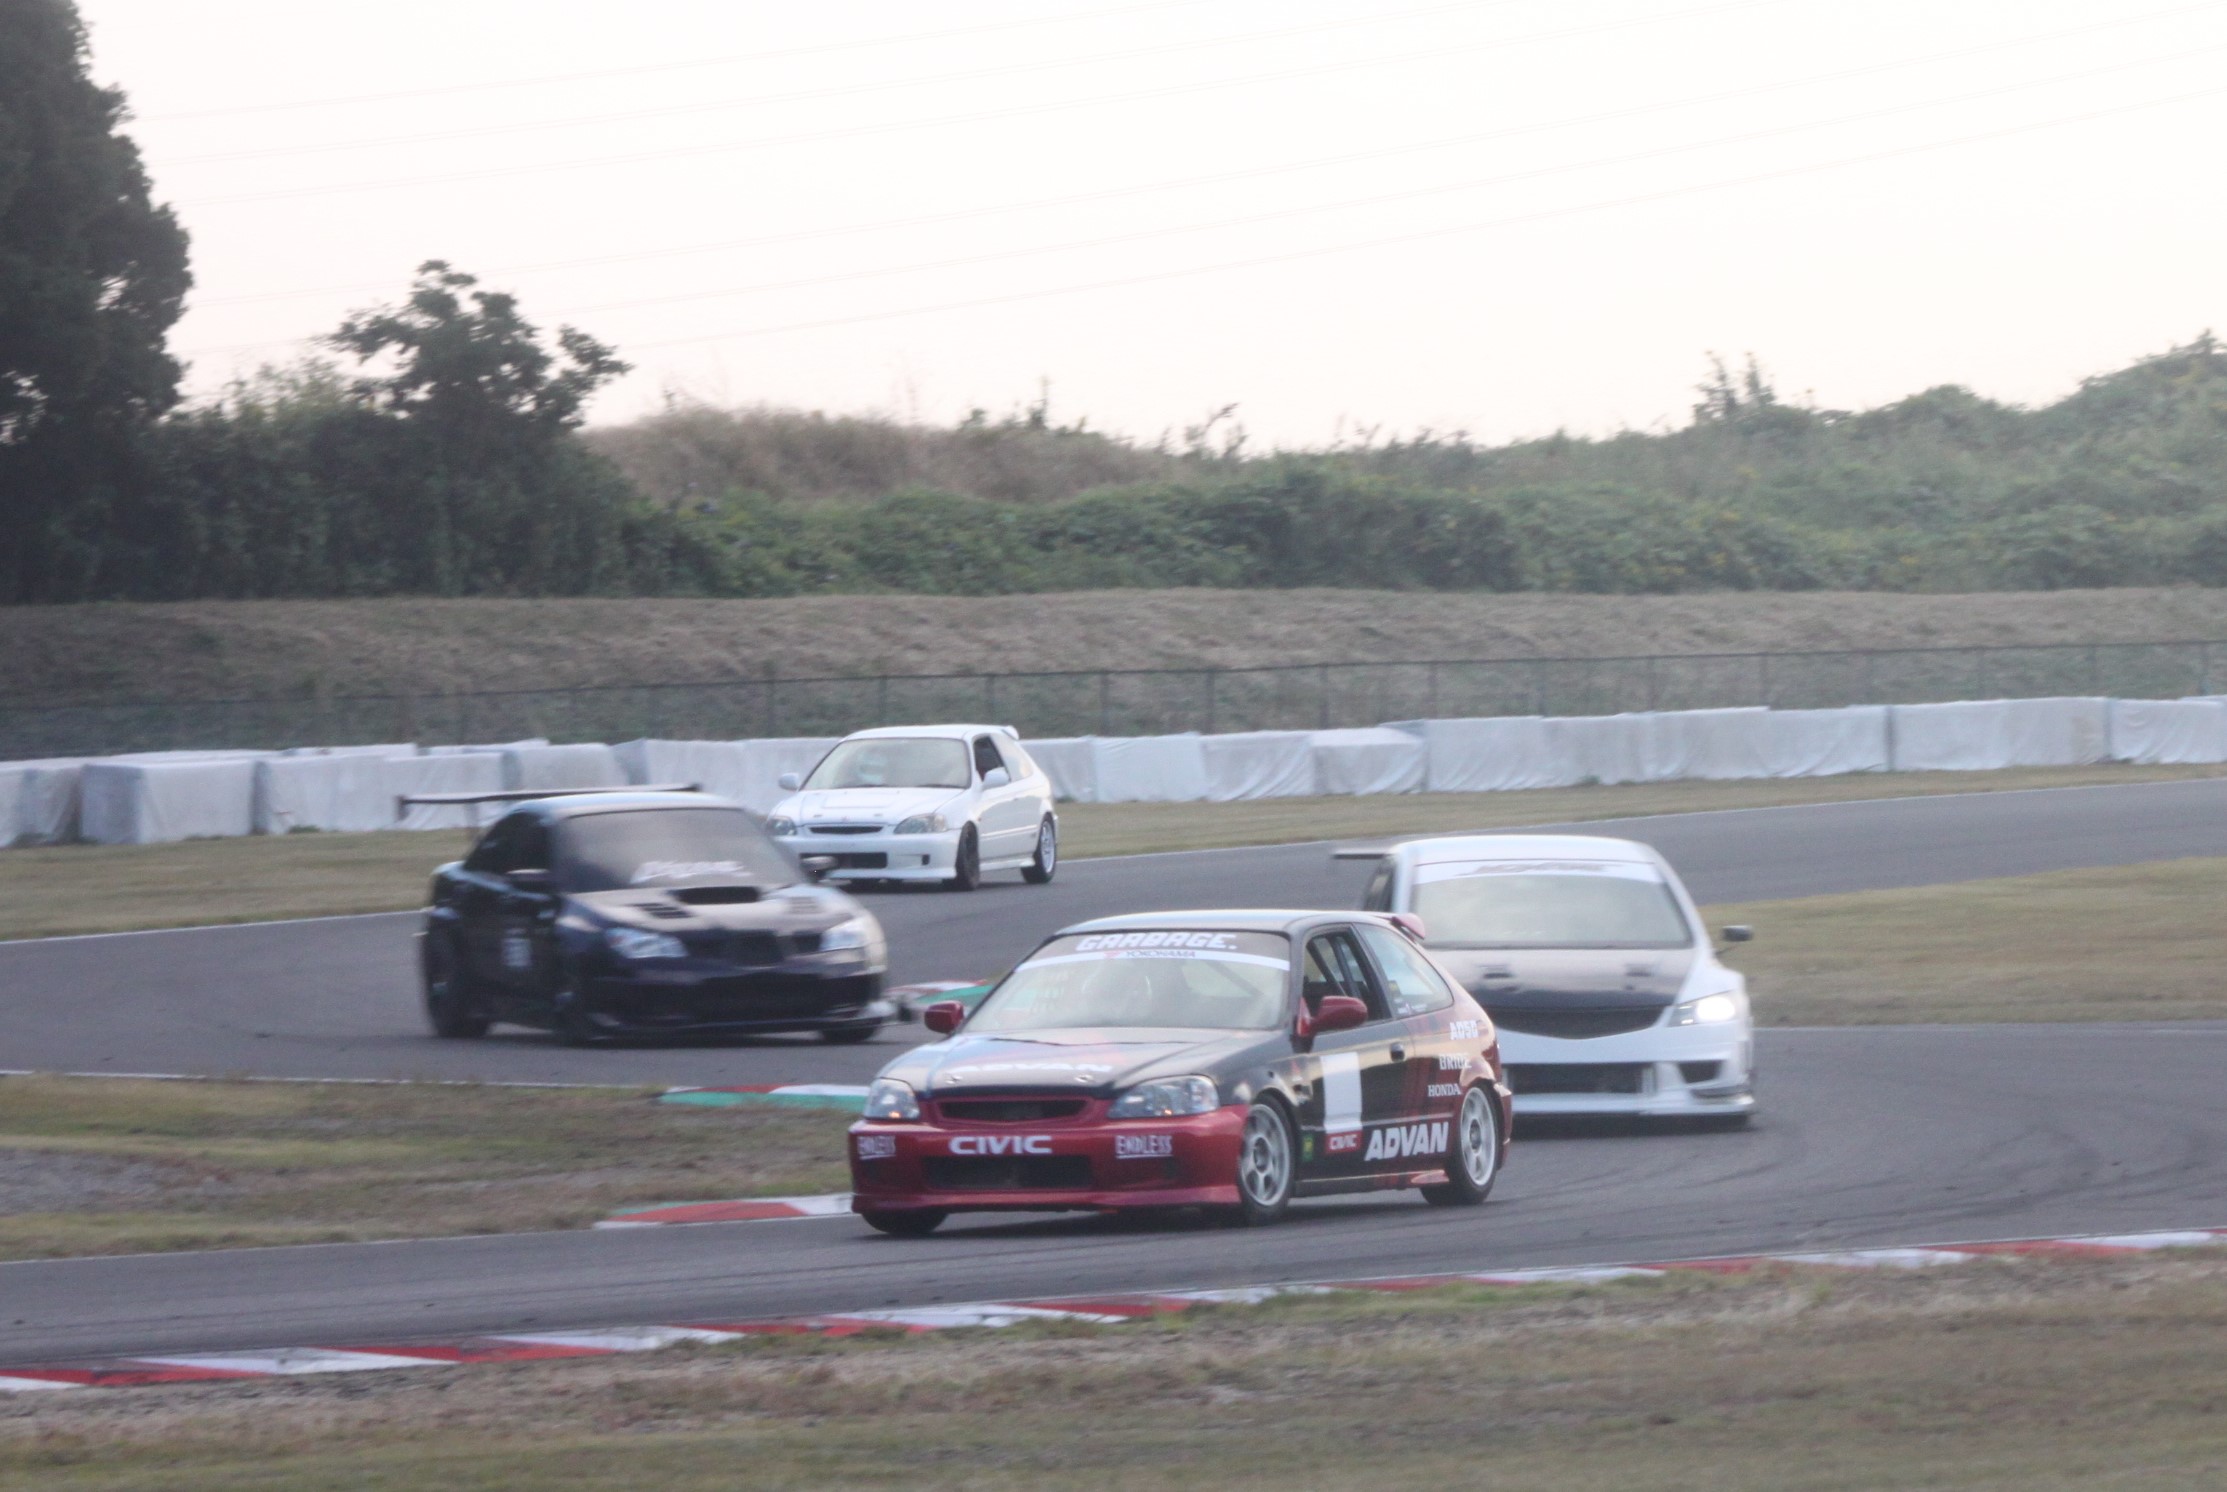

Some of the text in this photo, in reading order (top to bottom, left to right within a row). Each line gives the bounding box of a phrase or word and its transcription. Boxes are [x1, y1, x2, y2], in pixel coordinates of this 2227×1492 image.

[1428, 1083, 1462, 1098] HONDA
[950, 1135, 1053, 1155] CIVIC
[1115, 1135, 1172, 1155] ENDLESS
[1364, 1122, 1449, 1161] ADVAN
